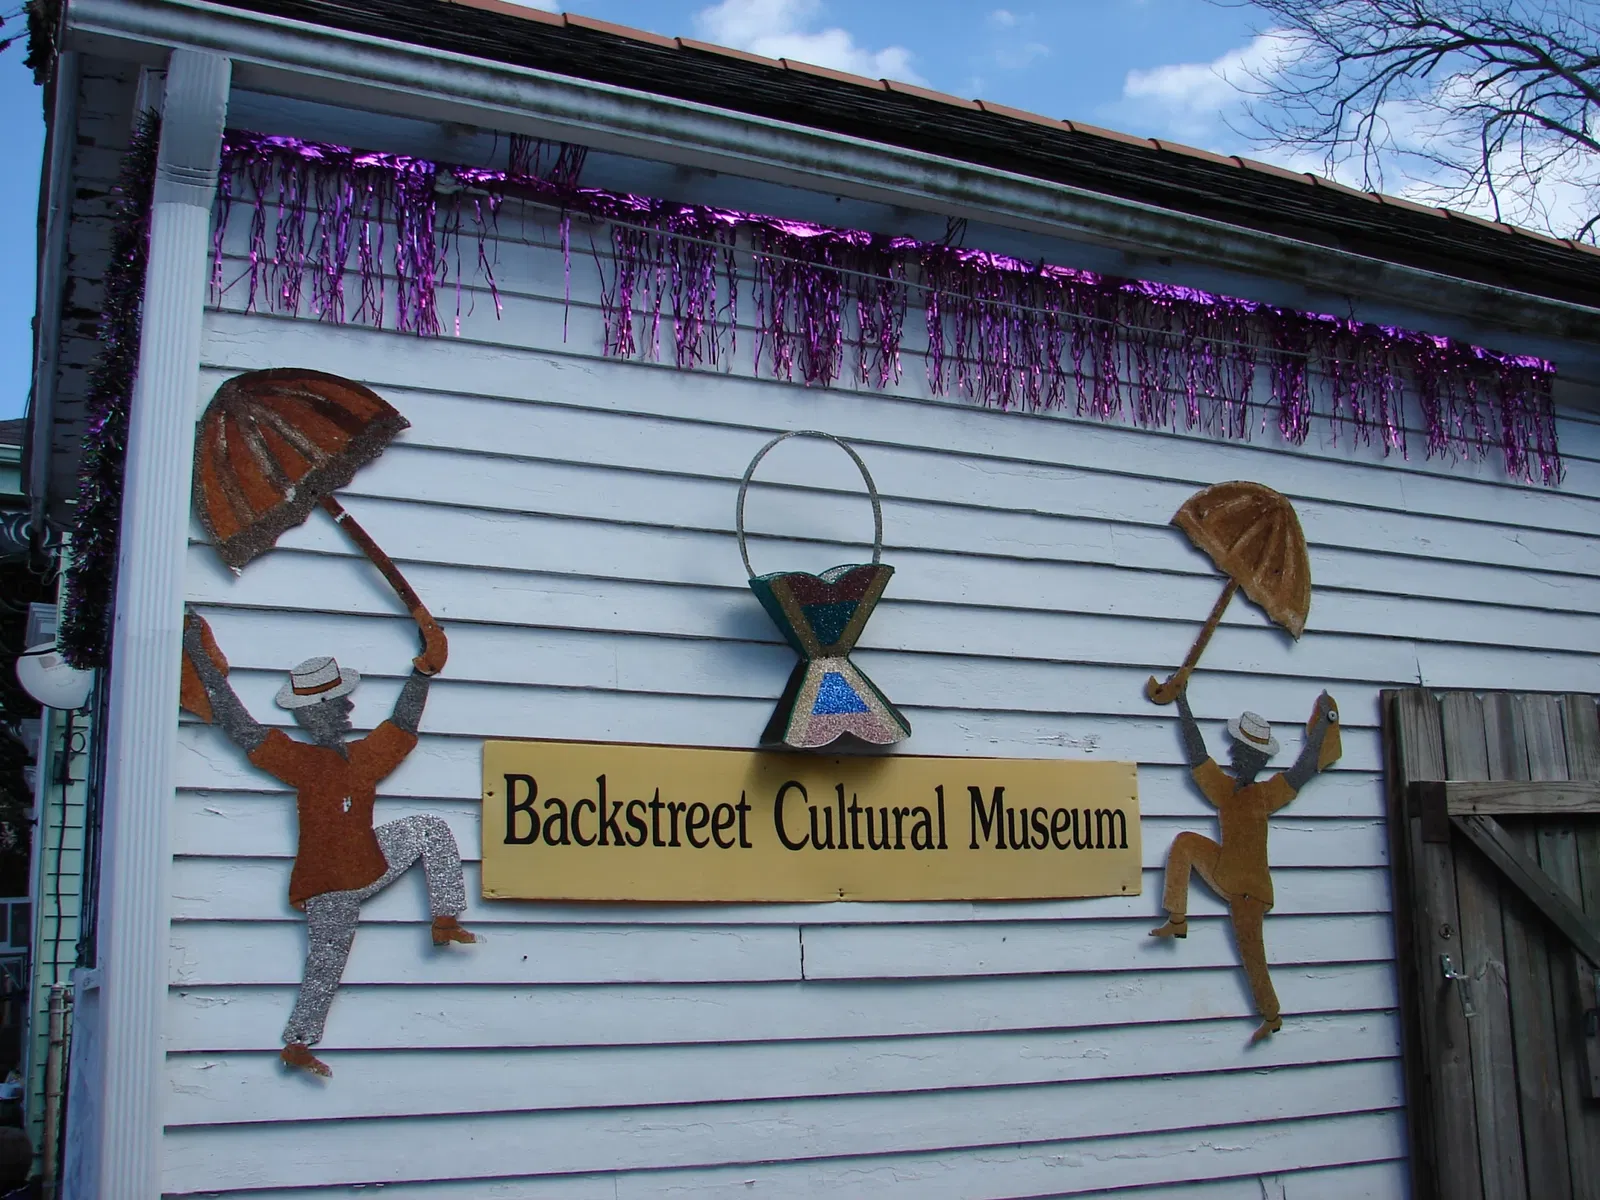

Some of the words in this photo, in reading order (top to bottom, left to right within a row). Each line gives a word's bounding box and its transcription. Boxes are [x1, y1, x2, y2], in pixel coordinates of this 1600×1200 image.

[503, 773, 753, 849] Backstreet
[774, 780, 949, 851] Cultural
[967, 785, 1129, 850] Museum
